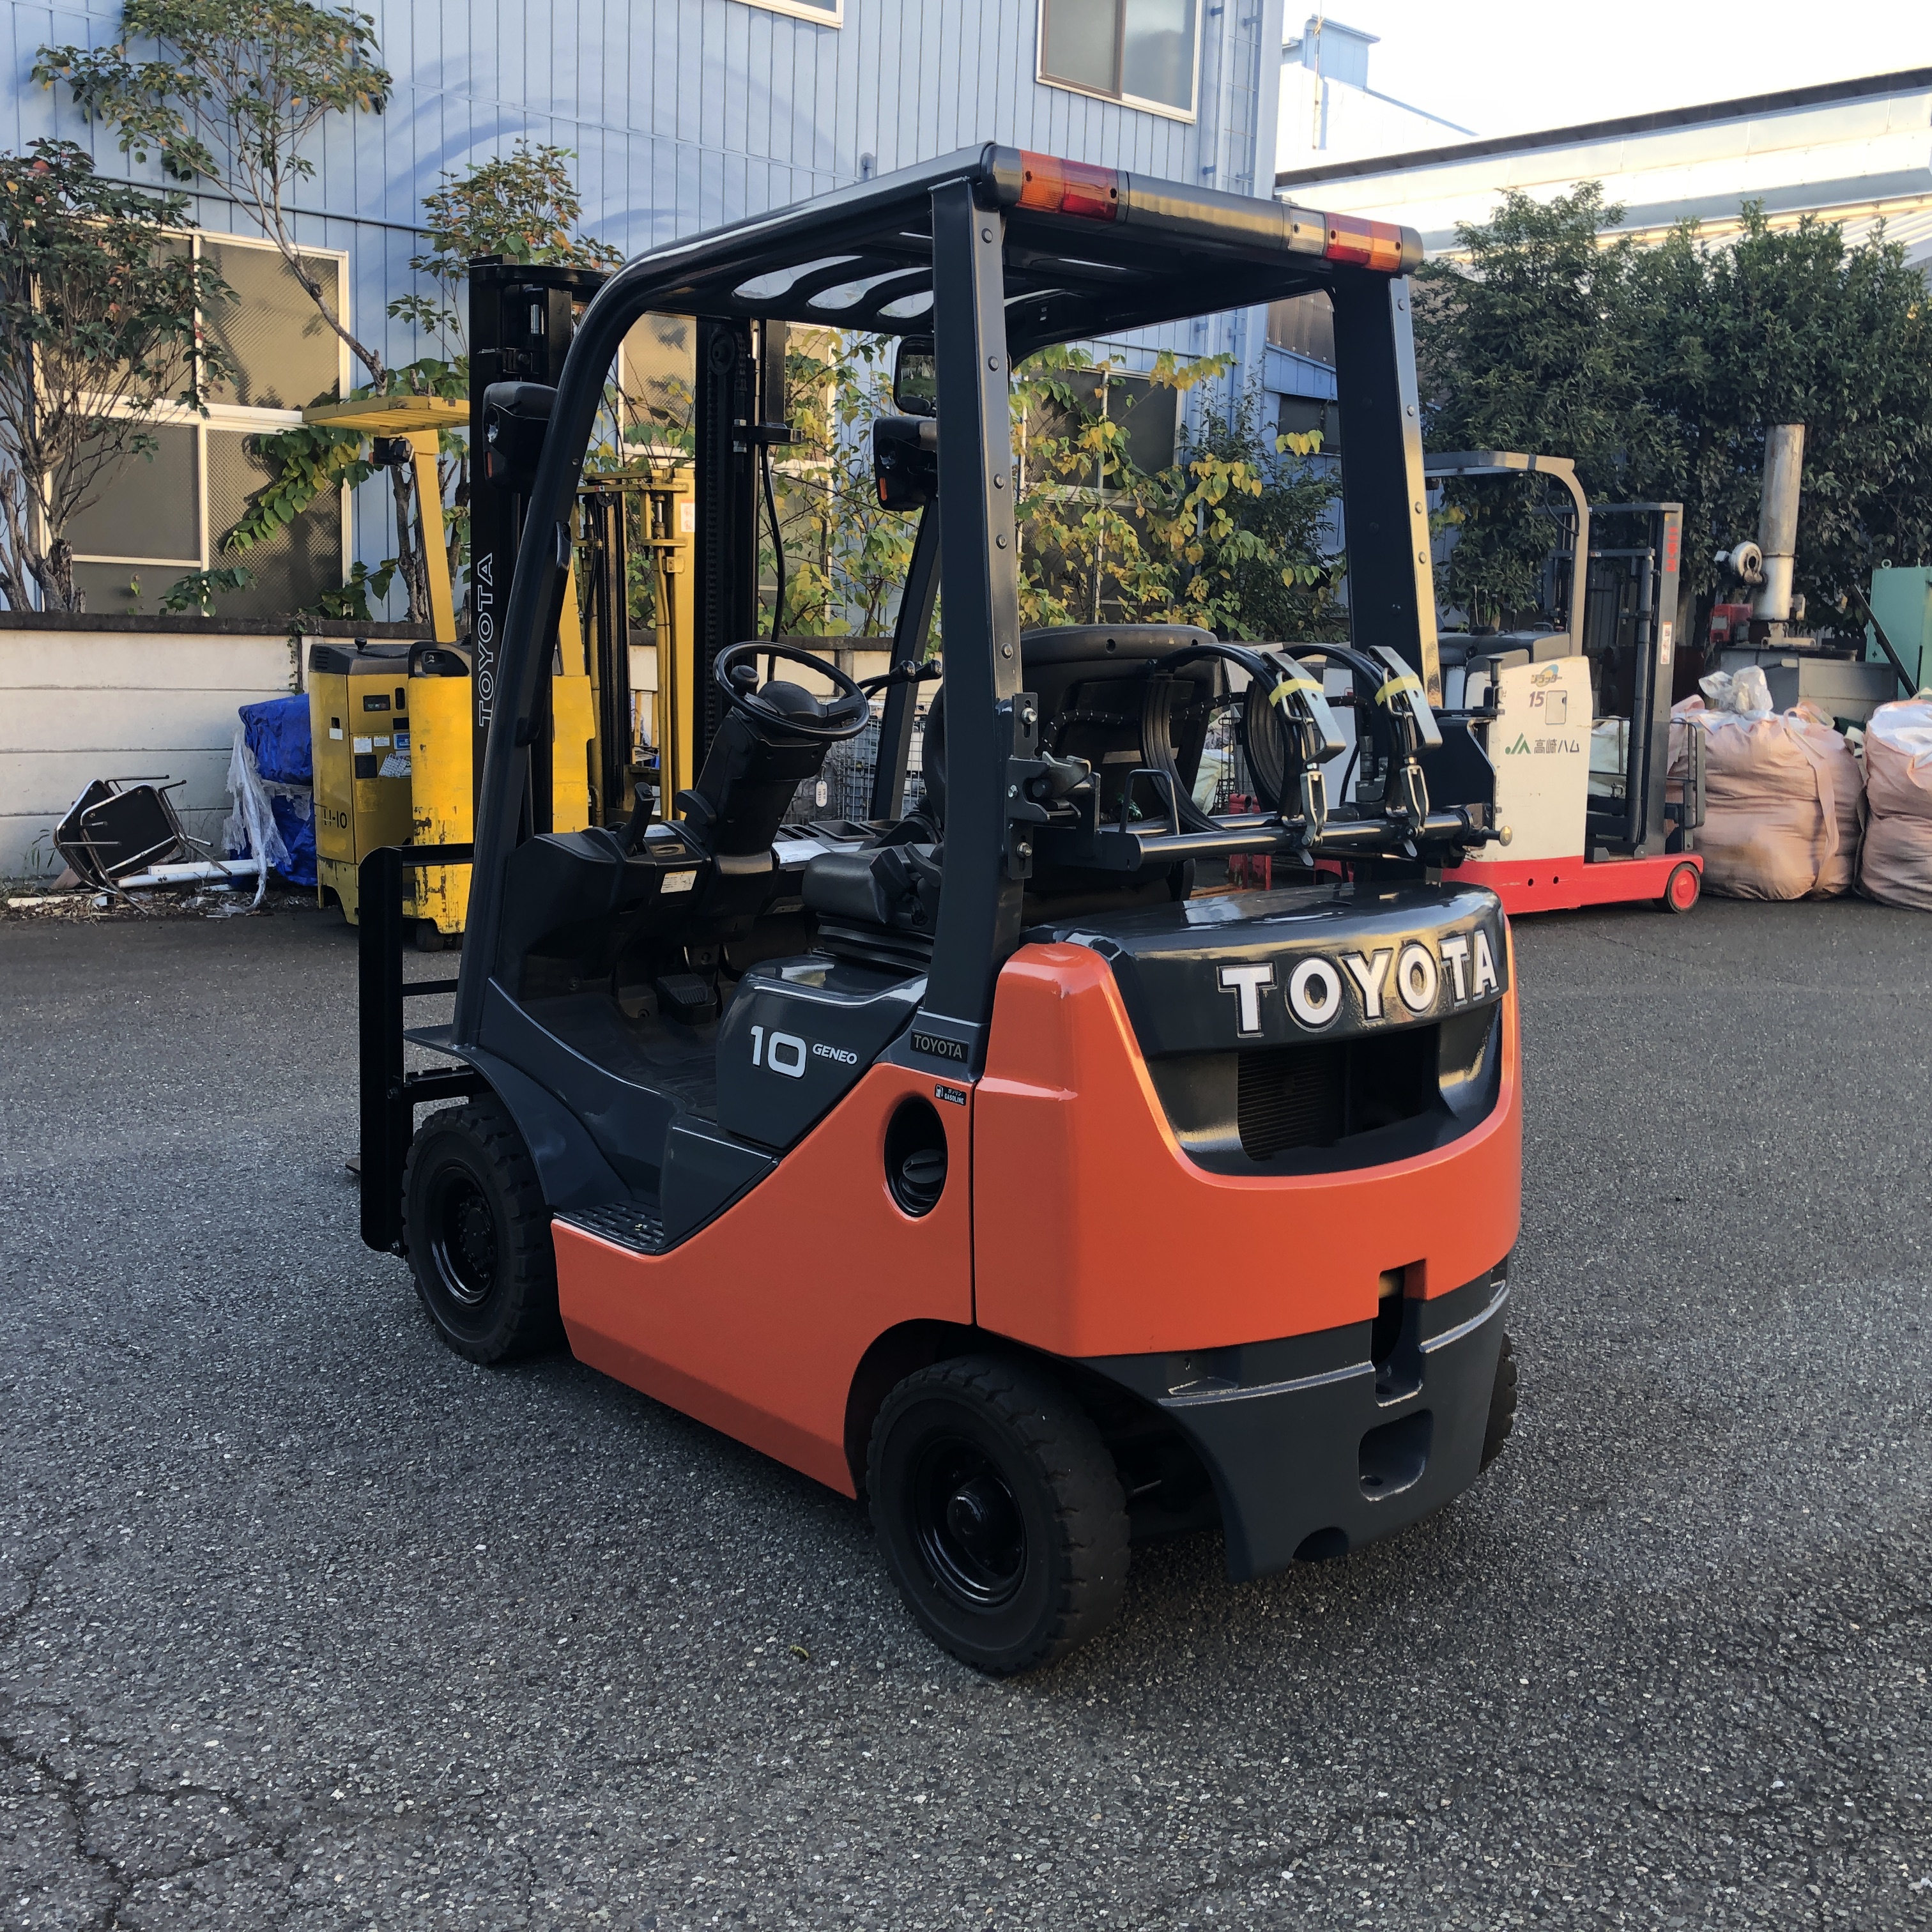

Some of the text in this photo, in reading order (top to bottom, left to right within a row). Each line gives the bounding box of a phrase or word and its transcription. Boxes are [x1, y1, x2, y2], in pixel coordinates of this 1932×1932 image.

[477, 552, 494, 727] TOYOTA
[1529, 691, 1545, 708] 15
[1218, 929, 1499, 1036] TOYOTA
[750, 1025, 857, 1078] 10 GENEO
[914, 1034, 962, 1059] TOYOTA
[944, 1092, 964, 1105] GASOLINE
